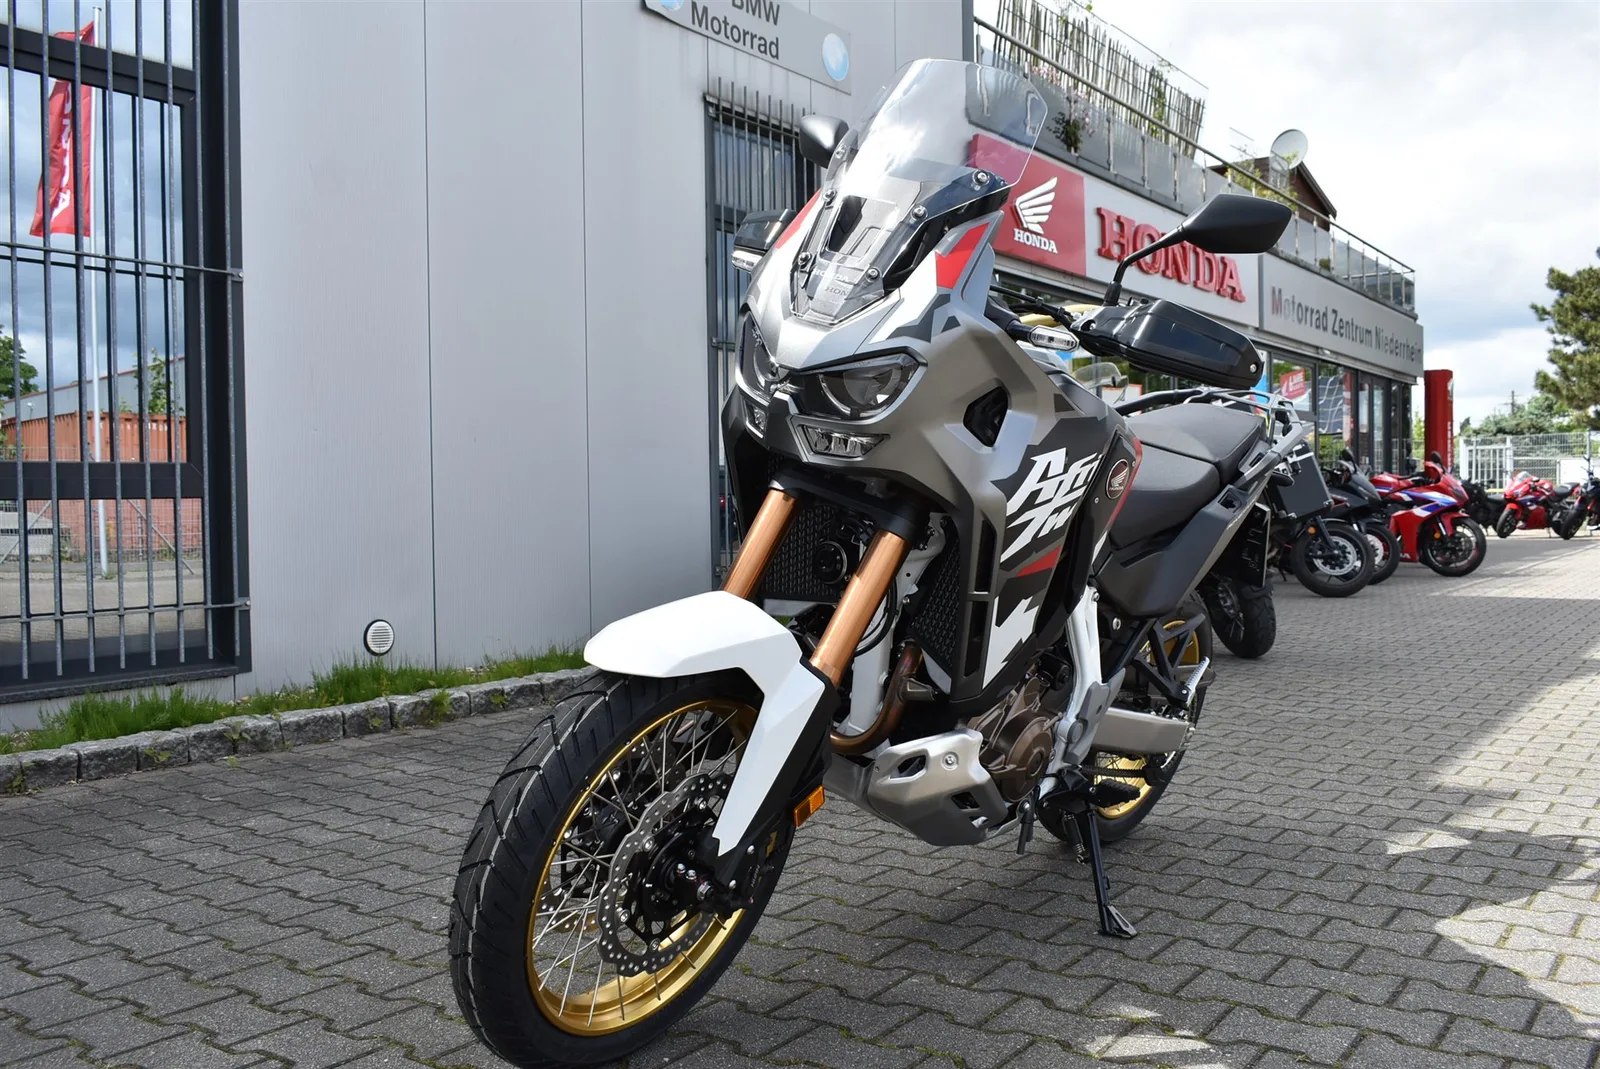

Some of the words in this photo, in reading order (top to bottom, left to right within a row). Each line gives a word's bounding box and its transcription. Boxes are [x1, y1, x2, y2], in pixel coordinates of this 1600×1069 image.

[691, 1, 780, 60] Motorrad
[1013, 227, 1058, 254] HONDA
[1096, 206, 1246, 303] HONDA
[1271, 286, 1328, 332] Motorrad
[1331, 308, 1373, 350] Zentrum
